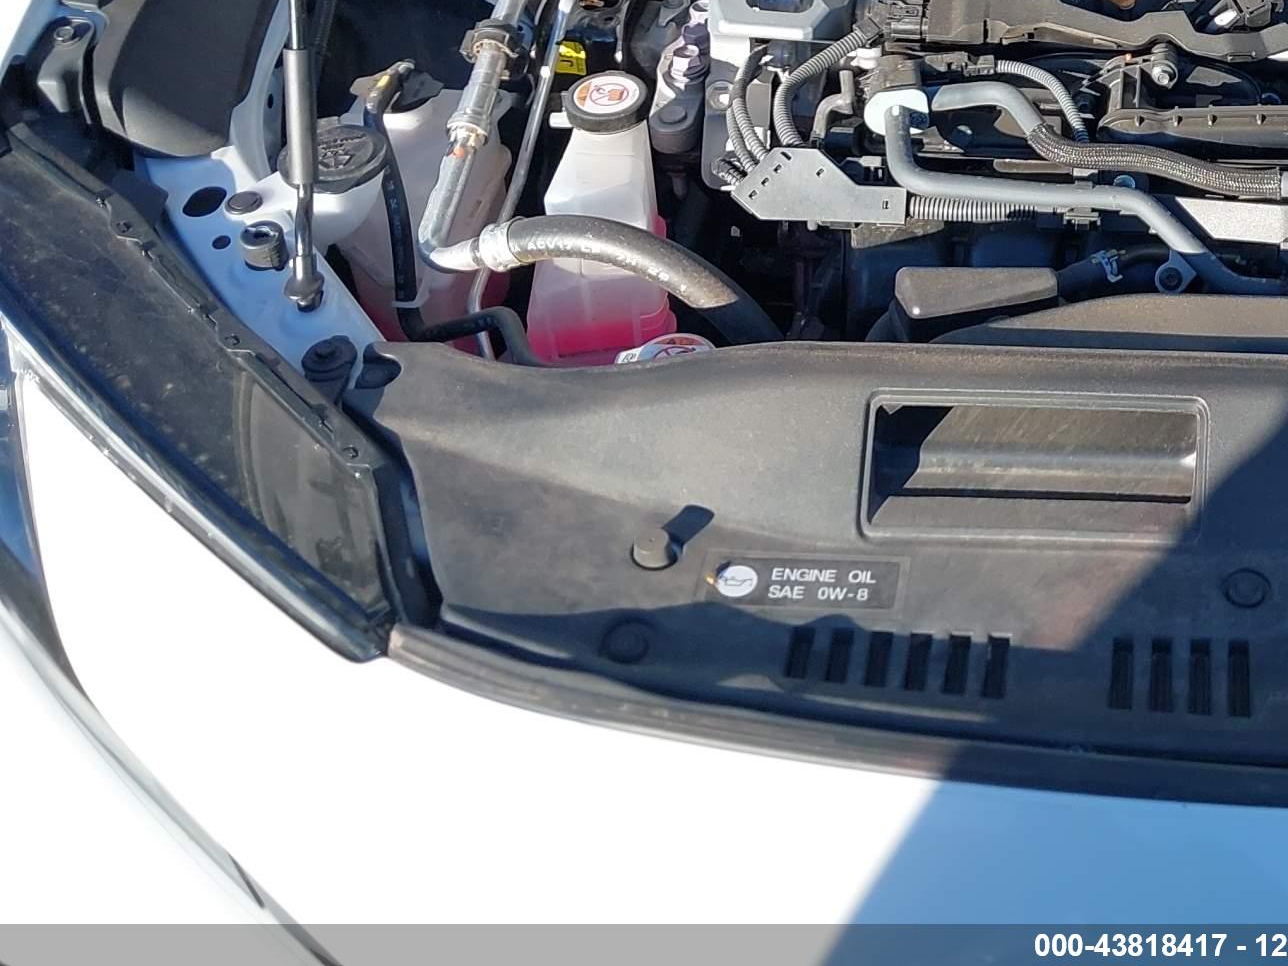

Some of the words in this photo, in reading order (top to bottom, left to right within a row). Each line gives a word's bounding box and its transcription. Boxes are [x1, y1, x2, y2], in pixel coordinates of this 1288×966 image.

[771, 567, 838, 583] ENGINE
[848, 569, 877, 584] OIL
[768, 585, 805, 600] SAE
[817, 586, 868, 601] 0W-8
